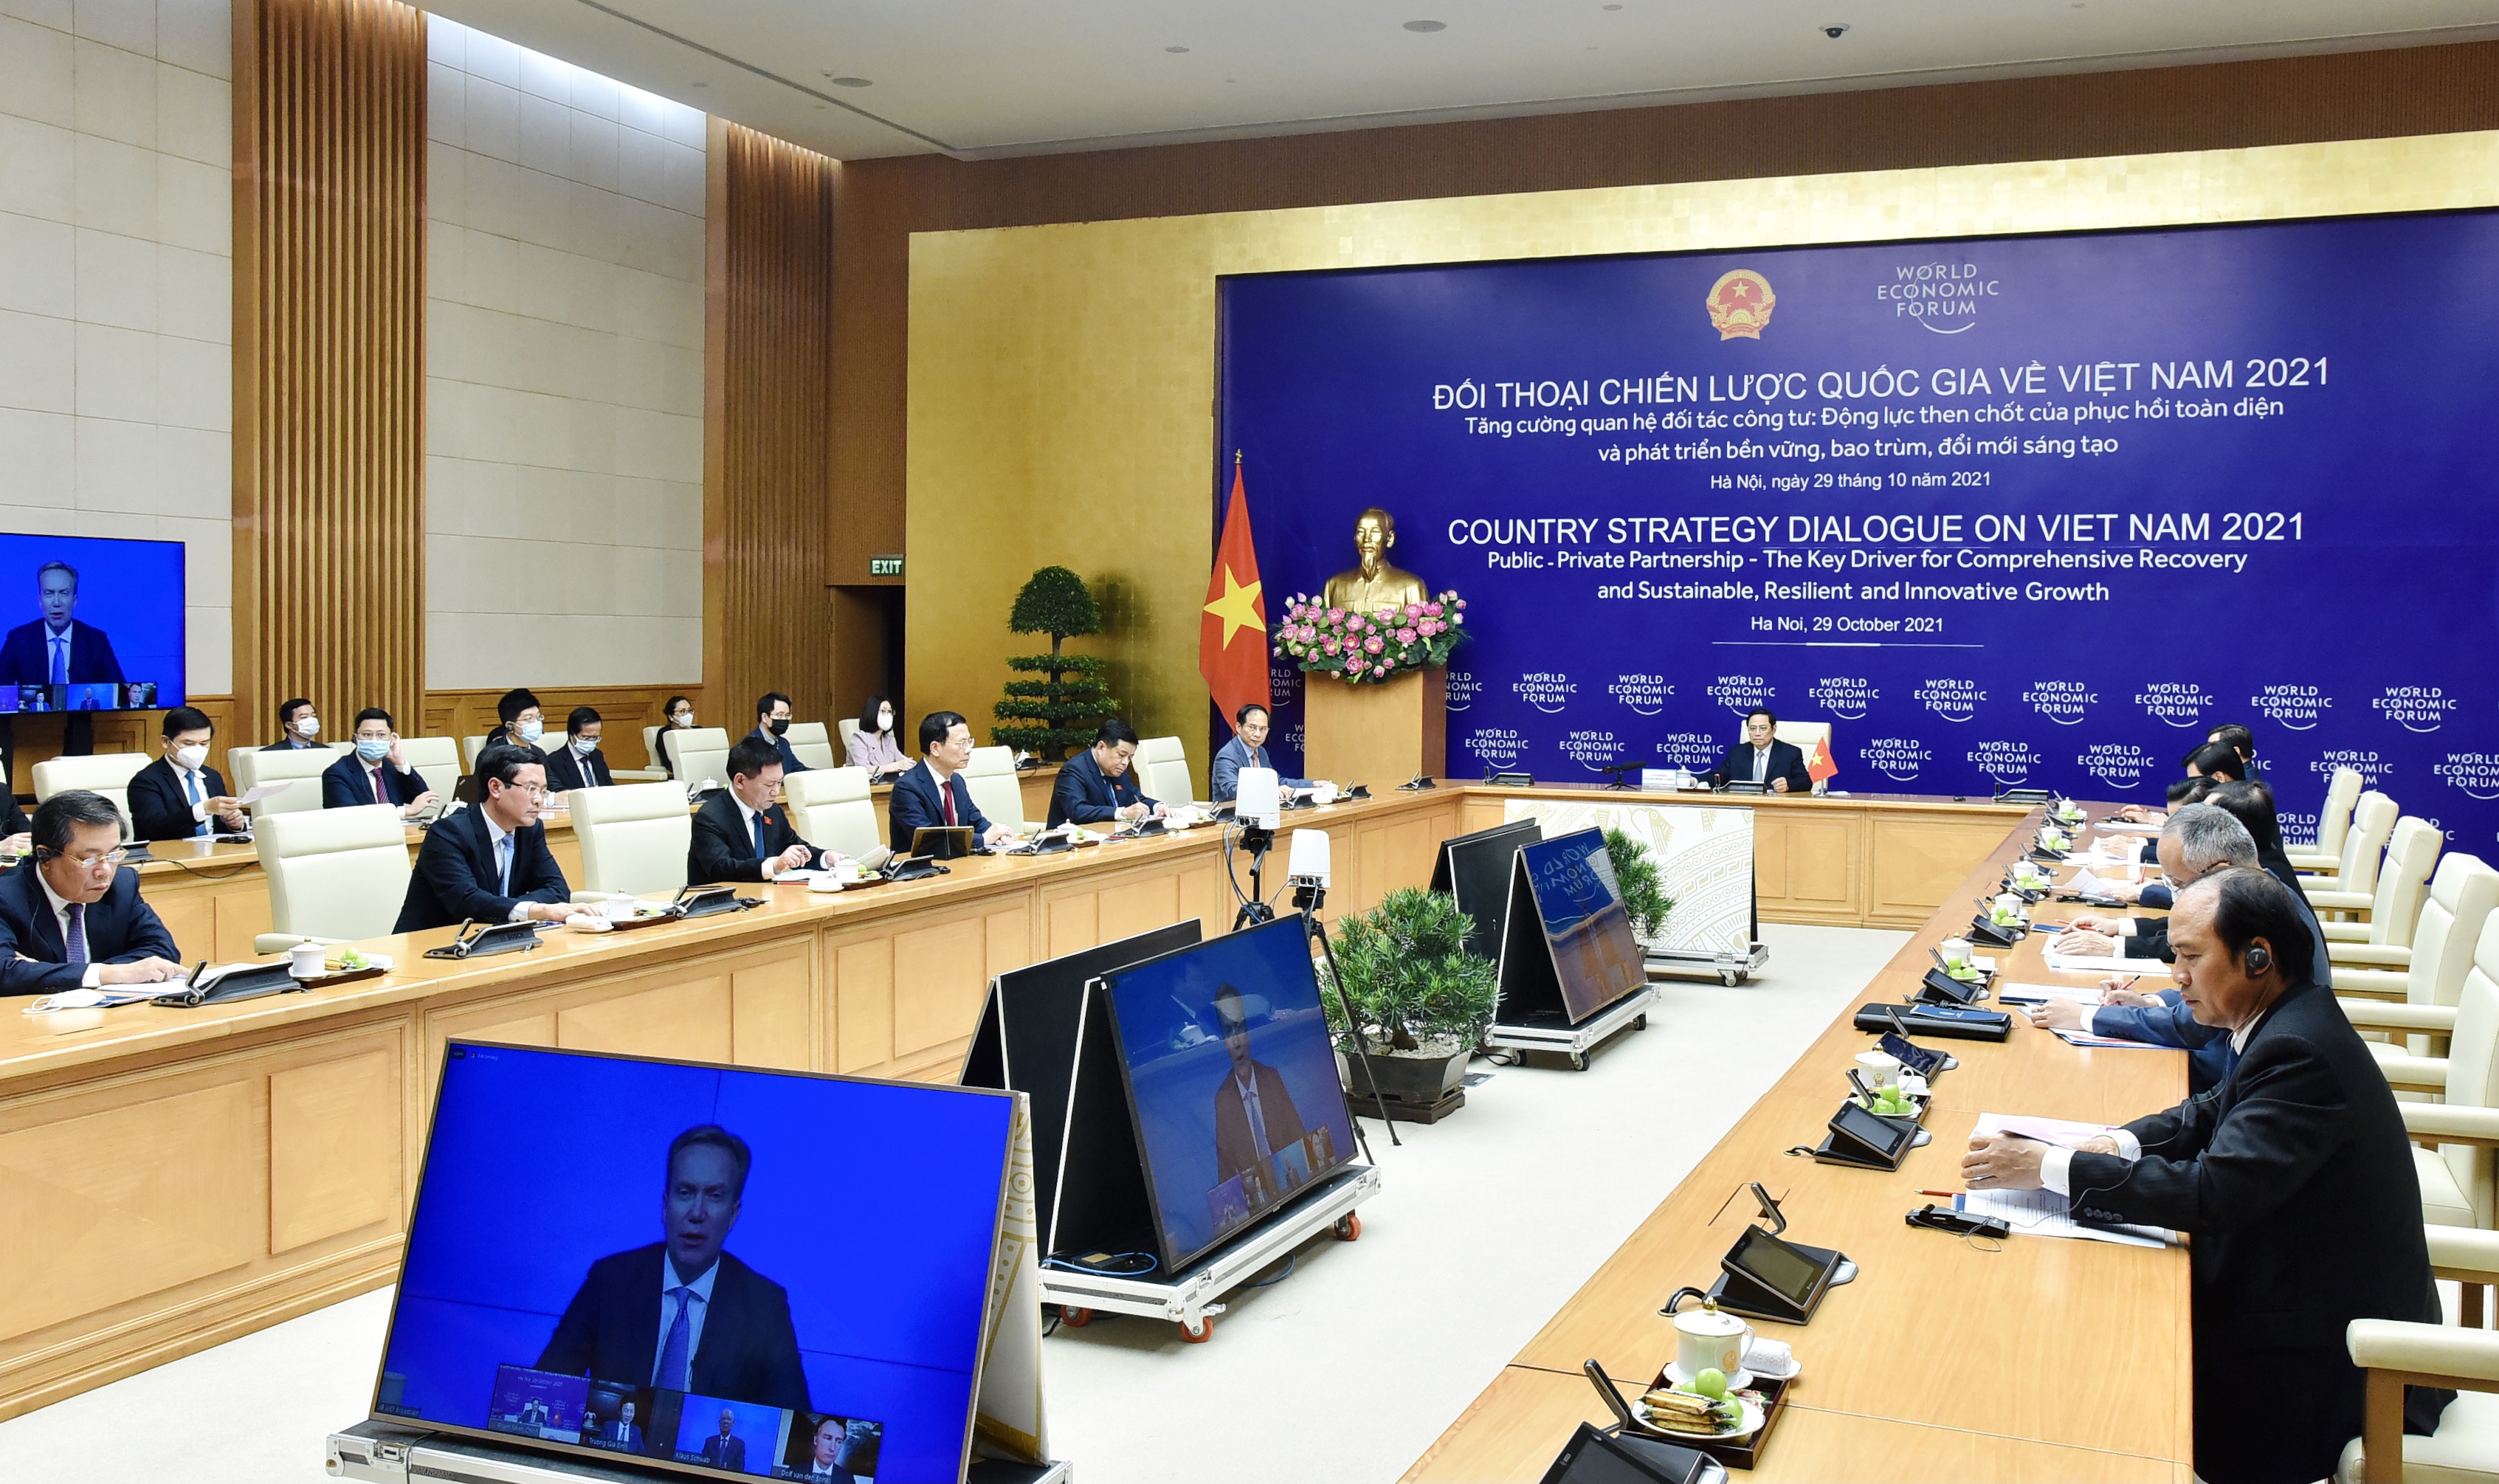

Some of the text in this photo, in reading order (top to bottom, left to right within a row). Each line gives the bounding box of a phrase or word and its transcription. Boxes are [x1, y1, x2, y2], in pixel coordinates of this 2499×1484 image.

[1896, 263, 1977, 281] WORLD
[1878, 280, 1999, 300] ECONOMIC
[1897, 300, 1976, 317] FORUM
[1433, 357, 2326, 410] ĐỐI THOẠI CHIẾN LƯỢC QUỐC GIA VỀ VIỆT NAM 2021
[1465, 397, 2283, 438] Tăng cường quan hệ đối tác công tư: Động lực then chốt của phục hồi toàn diện
[1599, 433, 2118, 465] và phát triển bền vững, bao trùm, đổi mới sáng tạo
[1712, 472, 1989, 491] Hà Nội, ngày 29 tháng 10 năm 2021
[1449, 512, 2301, 545] COUNTRY STRATEGY DIALOGUE ON VIET NAM 2021
[872, 559, 902, 574] EXIT
[1489, 551, 1543, 568] Public
[1558, 551, 1624, 568] Private
[1630, 551, 1743, 572] Partnership
[1762, 550, 1802, 567] The
[1808, 550, 1846, 573] Key
[1852, 550, 1917, 567] Driver
[1921, 549, 1952, 567] for
[1957, 549, 2133, 572] Comprehensive
[2140, 549, 2247, 573] Recovery
[1598, 581, 2109, 601] and Sustainable, Resilient and Innovative Growth
[1752, 617, 1942, 632] Ha Noi, 29 October 2021
[1271, 669, 1291, 677] RLD
[1447, 672, 1472, 681] RLD
[1523, 673, 1566, 683] WORLD
[1270, 679, 1301, 687] OMIC
[1619, 674, 1664, 685] WORLD
[1717, 676, 1764, 686] WORLD
[1819, 677, 1867, 688] WORLD
[1925, 679, 1974, 690] WORLD
[1446, 682, 1483, 691] NOMIC
[1512, 683, 1577, 694] ECONOMIC
[1608, 684, 1675, 695] ECONOMIC
[1707, 686, 1776, 697] ECONOMIC
[2034, 681, 2085, 692] WORLD
[2147, 683, 2199, 694] WORLD
[2264, 685, 2318, 697] WORLD
[2385, 686, 2442, 698] WORLD
[1446, 692, 1471, 701] RUM
[1523, 693, 1565, 703] FORUM
[1809, 688, 1880, 699] ECONOMIC
[1914, 689, 1987, 701] ECONOMIC
[2022, 691, 2098, 704] ECONOMIC
[1619, 694, 1663, 705] FORUM
[1717, 697, 1763, 707] FORUM
[1820, 699, 1867, 709] FORUM
[2134, 694, 2213, 705] ECONOMIC
[2251, 696, 2332, 708] ECONOMIC
[2372, 698, 2457, 710] ECONOMIC
[1926, 700, 1974, 711] FORUM
[2034, 703, 2084, 714] FORUM
[2147, 705, 2199, 717] FORUM
[2264, 708, 2317, 719] FORUM
[2385, 710, 2441, 721] FORUM
[1475, 728, 1517, 739] WORLD
[1569, 731, 1613, 742] WORLD
[1666, 734, 1712, 744] WORLD
[1465, 738, 1528, 750] ECONOMIC
[1559, 740, 1625, 752] ECONOMIC
[1656, 743, 1724, 754] ECONOMIC
[1871, 738, 1920, 749] WORLD
[1978, 741, 2028, 753] WORLD
[1475, 748, 1517, 759] FORUM
[1860, 748, 1932, 761] ECONOMIC
[2089, 745, 2141, 756] WORLD
[2323, 750, 2378, 762] WORLD
[1570, 751, 1613, 762] FORUM
[1667, 753, 1712, 765] FORUM
[1967, 751, 2041, 764] ECONOMIC
[2078, 755, 2154, 767] ECONOMIC
[1871, 759, 1919, 770] FORUM
[1979, 763, 2027, 774] FORUM
[2089, 766, 2140, 778] FORUM
[2433, 765, 2499, 776] ECONOM
[2276, 813, 2316, 824] ORLD
[2283, 835, 2315, 846] RUM
[675, 1452, 689, 1460] Klaus
